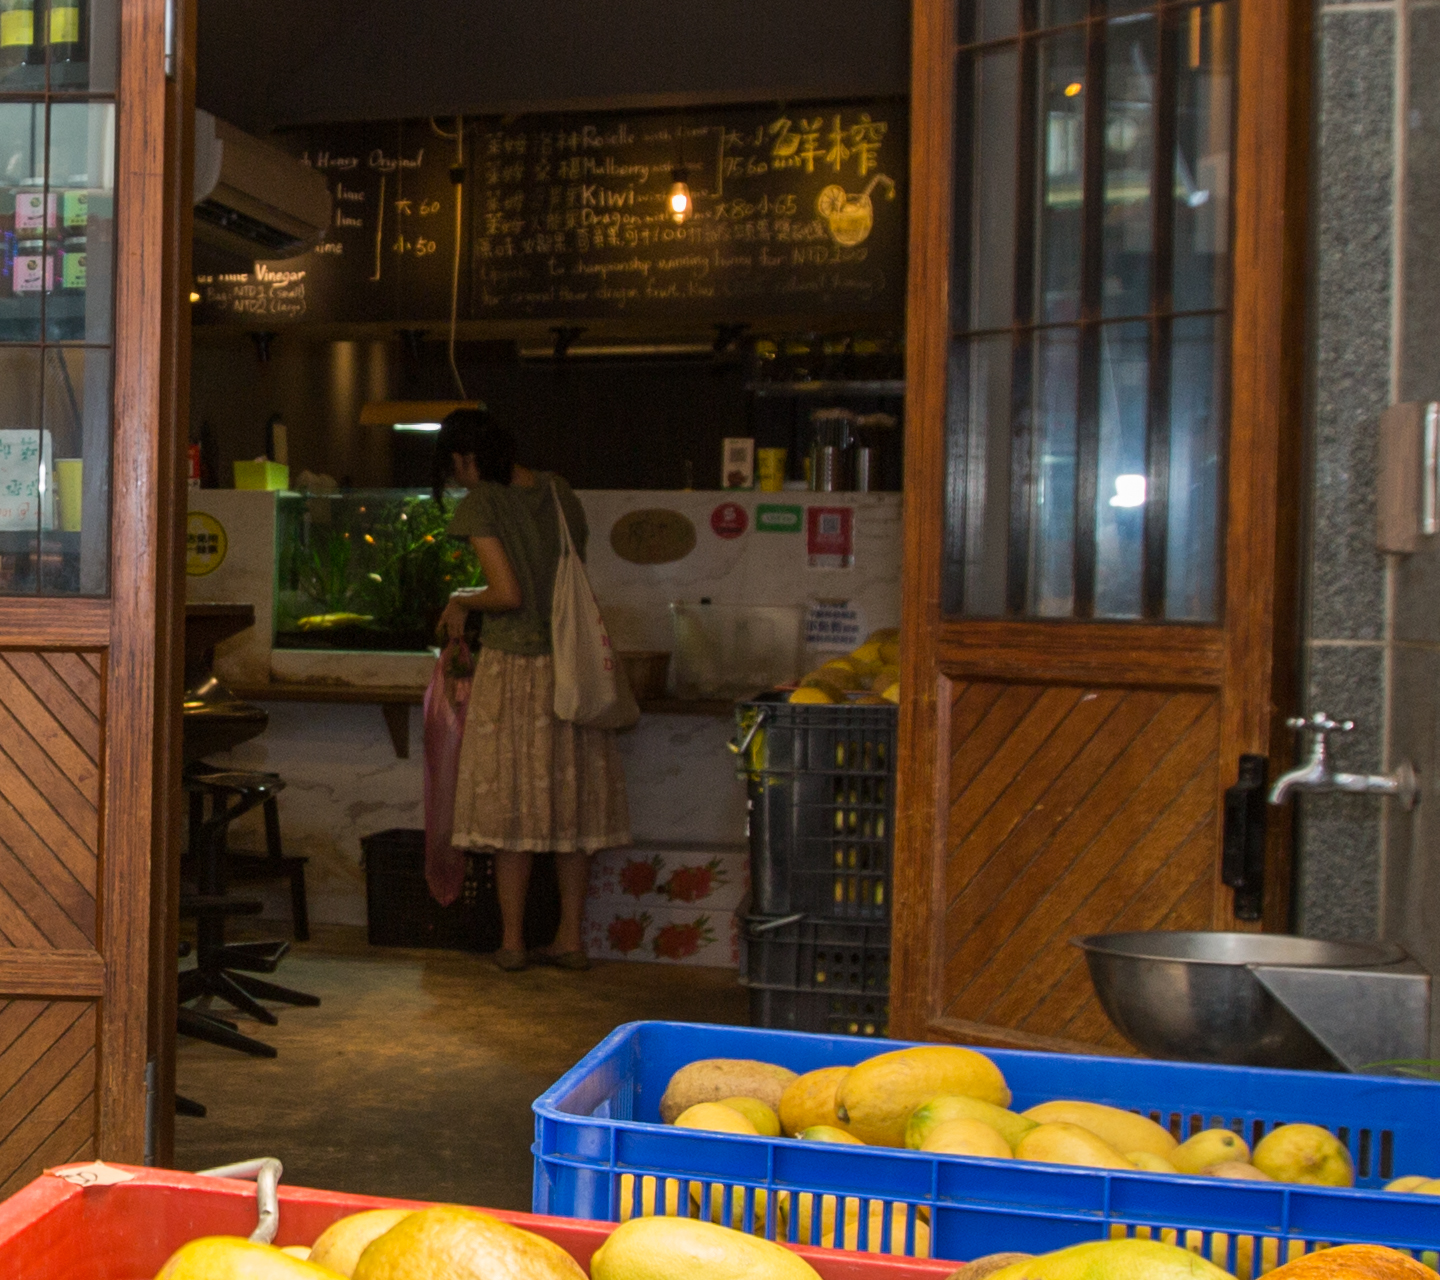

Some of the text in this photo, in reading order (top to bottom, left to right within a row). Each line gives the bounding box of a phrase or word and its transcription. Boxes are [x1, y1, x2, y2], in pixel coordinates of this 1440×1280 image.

[769, 113, 887, 176] 鮮榨
[419, 198, 440, 216] 60
[581, 184, 635, 208] Kiwi
[415, 236, 437, 257] 50
[255, 263, 306, 287] Vinegar
